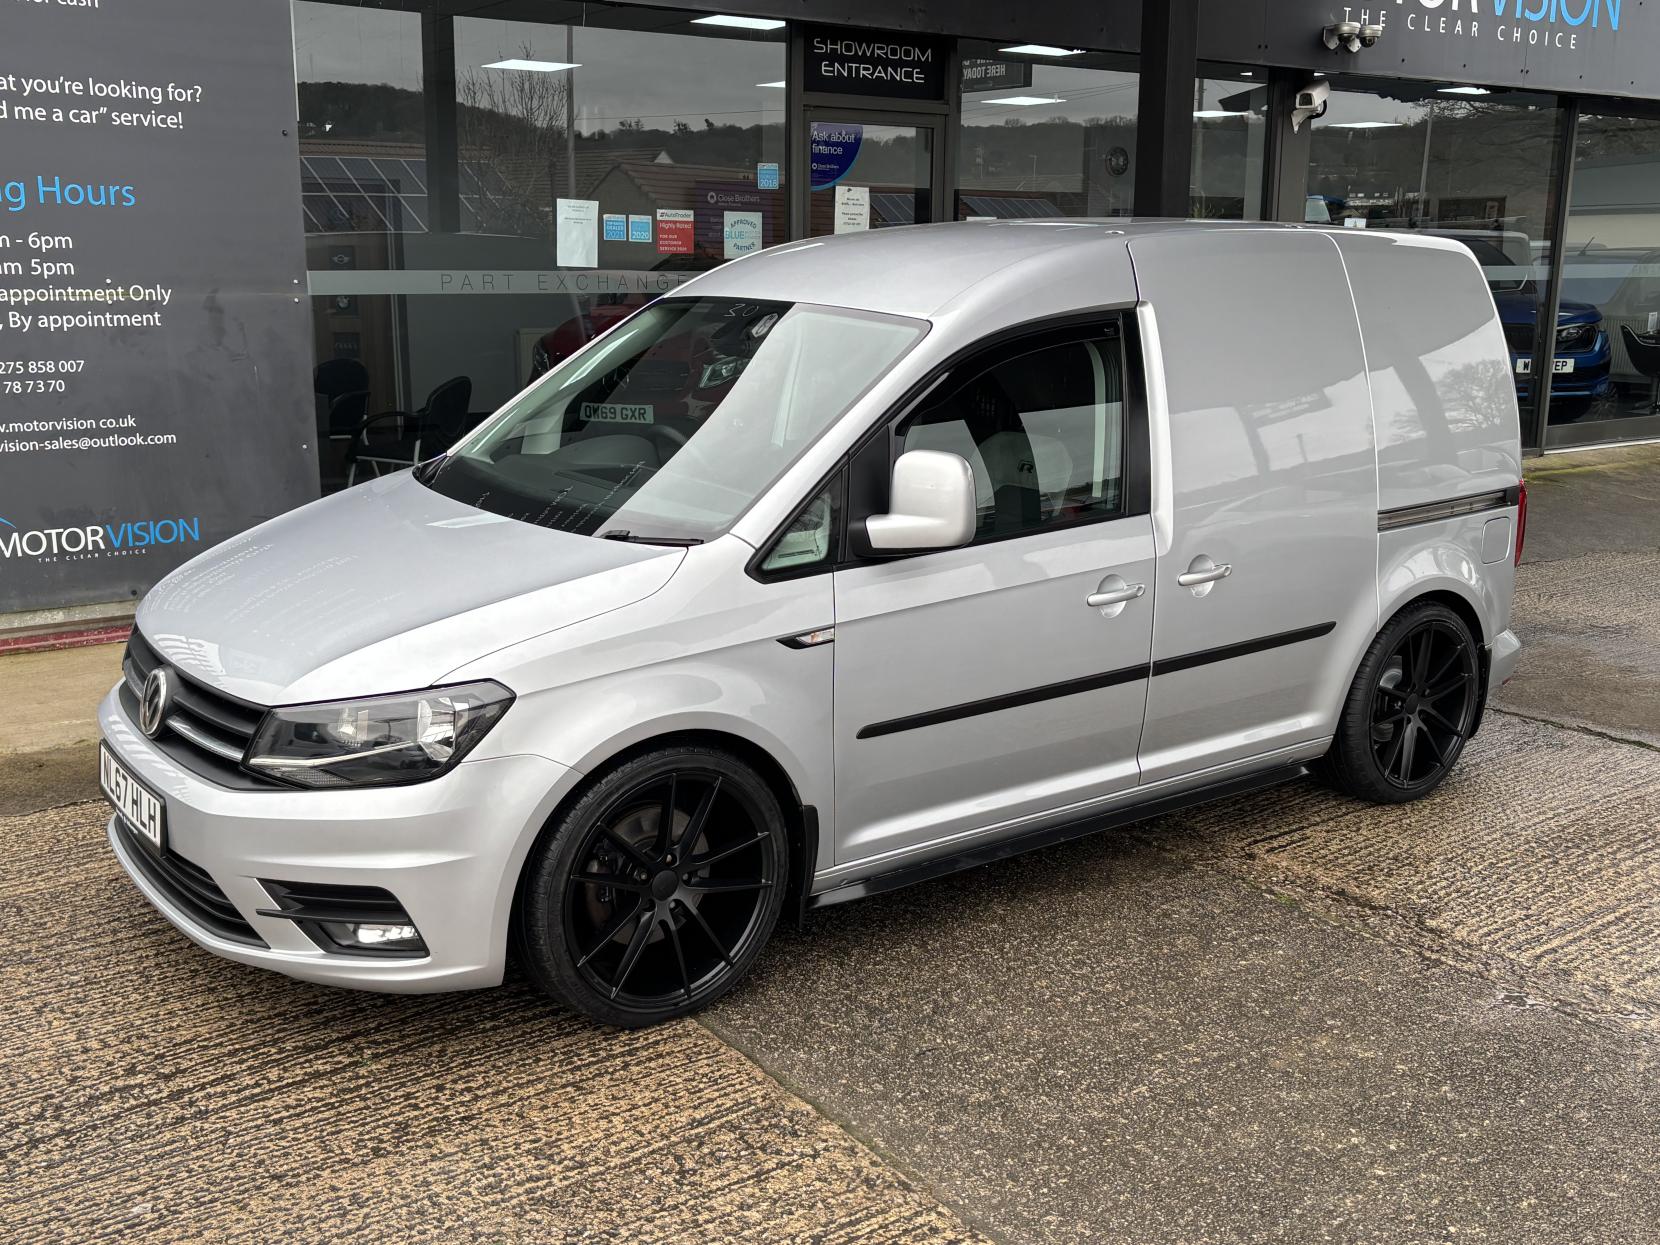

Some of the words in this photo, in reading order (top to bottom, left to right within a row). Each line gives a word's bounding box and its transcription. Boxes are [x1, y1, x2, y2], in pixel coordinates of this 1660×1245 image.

[1343, 7, 1387, 27] THE
[1408, 14, 1478, 37] CLEAR
[1497, 25, 1577, 49] CHOICE
[814, 38, 931, 62] SHOWROOM
[822, 61, 925, 83] ENTRANCE
[21, 76, 84, 97] you're
[89, 77, 163, 104] looking
[167, 83, 202, 103] for?
[14, 105, 47, 121] me
[52, 108, 63, 122] a
[111, 110, 184, 129] service!
[811, 130, 829, 142] Ask
[830, 131, 855, 143] about
[812, 143, 843, 155] finance
[0, 182, 26, 212] g
[37, 175, 136, 207] Hours
[718, 193, 734, 202] Close
[735, 194, 760, 202] Brothers
[730, 219, 757, 229] APPROVED
[28, 232, 73, 252] 6pm
[632, 231, 649, 239] 2020
[725, 230, 745, 240] BLUE
[733, 241, 756, 251] PARTNER
[0, 262, 23, 275] m
[31, 258, 75, 279] 5pm
[441, 273, 514, 291] PART
[538, 273, 687, 291] EXCHANGE
[0, 284, 124, 306] appointment
[129, 285, 172, 305] Only
[9, 311, 32, 332] By
[38, 311, 161, 332] appointment
[0, 361, 24, 374] 275
[28, 361, 56, 373] 858
[58, 360, 85, 373] 007
[1552, 361, 1567, 371] EP
[620, 407, 647, 421] GXR
[37, 556, 57, 564] THE
[66, 552, 99, 561] CLEAR
[107, 548, 147, 557] CHOICE
[103, 751, 128, 809] NL67
[132, 781, 157, 839] HLH
